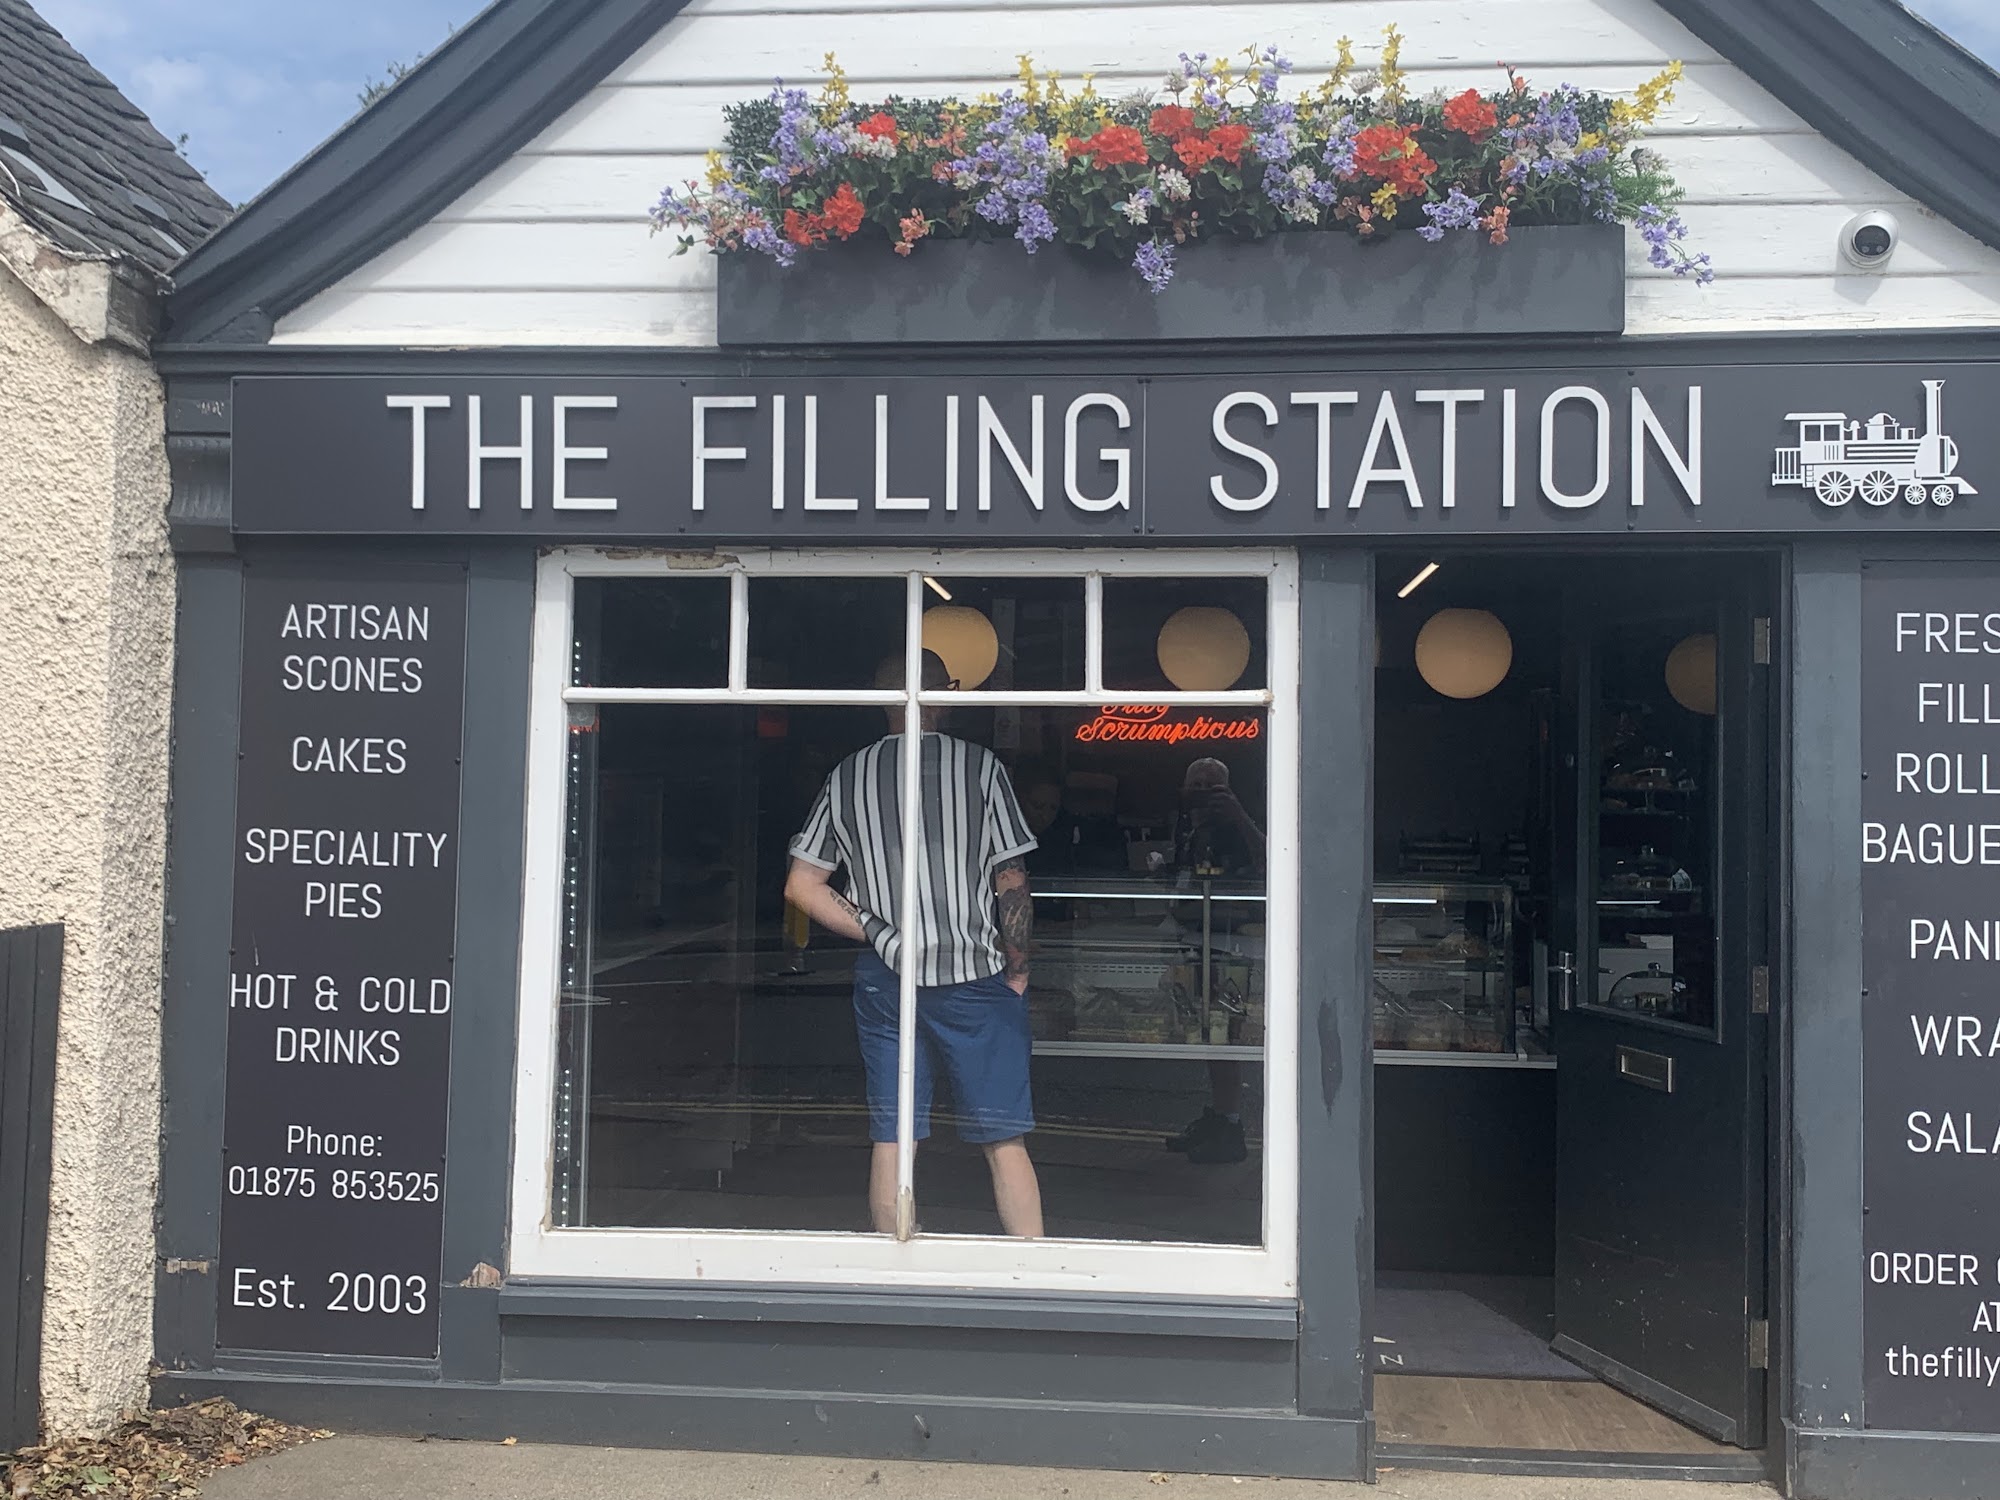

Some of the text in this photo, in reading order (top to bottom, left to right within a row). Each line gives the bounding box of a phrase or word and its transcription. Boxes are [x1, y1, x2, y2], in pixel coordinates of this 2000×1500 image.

[386, 385, 1702, 512] THE FILLING STATION
[281, 603, 429, 641] ARTISAN
[1896, 612, 2000, 654] FRES
[282, 655, 423, 693] SCONES
[1918, 682, 2000, 724] FILL
[1074, 714, 1261, 745] Scrumptious
[292, 736, 407, 774] CAKES
[1896, 752, 2000, 794] ROLL
[245, 828, 448, 868] SPECIALITY
[1862, 822, 2000, 865] BAGUE
[305, 881, 382, 919] PIES
[230, 973, 451, 1014] HOT & COLD
[276, 1027, 400, 1066] DRINKS
[287, 1125, 383, 1157] Phone:
[228, 1165, 439, 1202] 01875 853525
[1870, 1251, 1979, 1286] ORDER
[233, 1267, 427, 1315] Est. 2003
